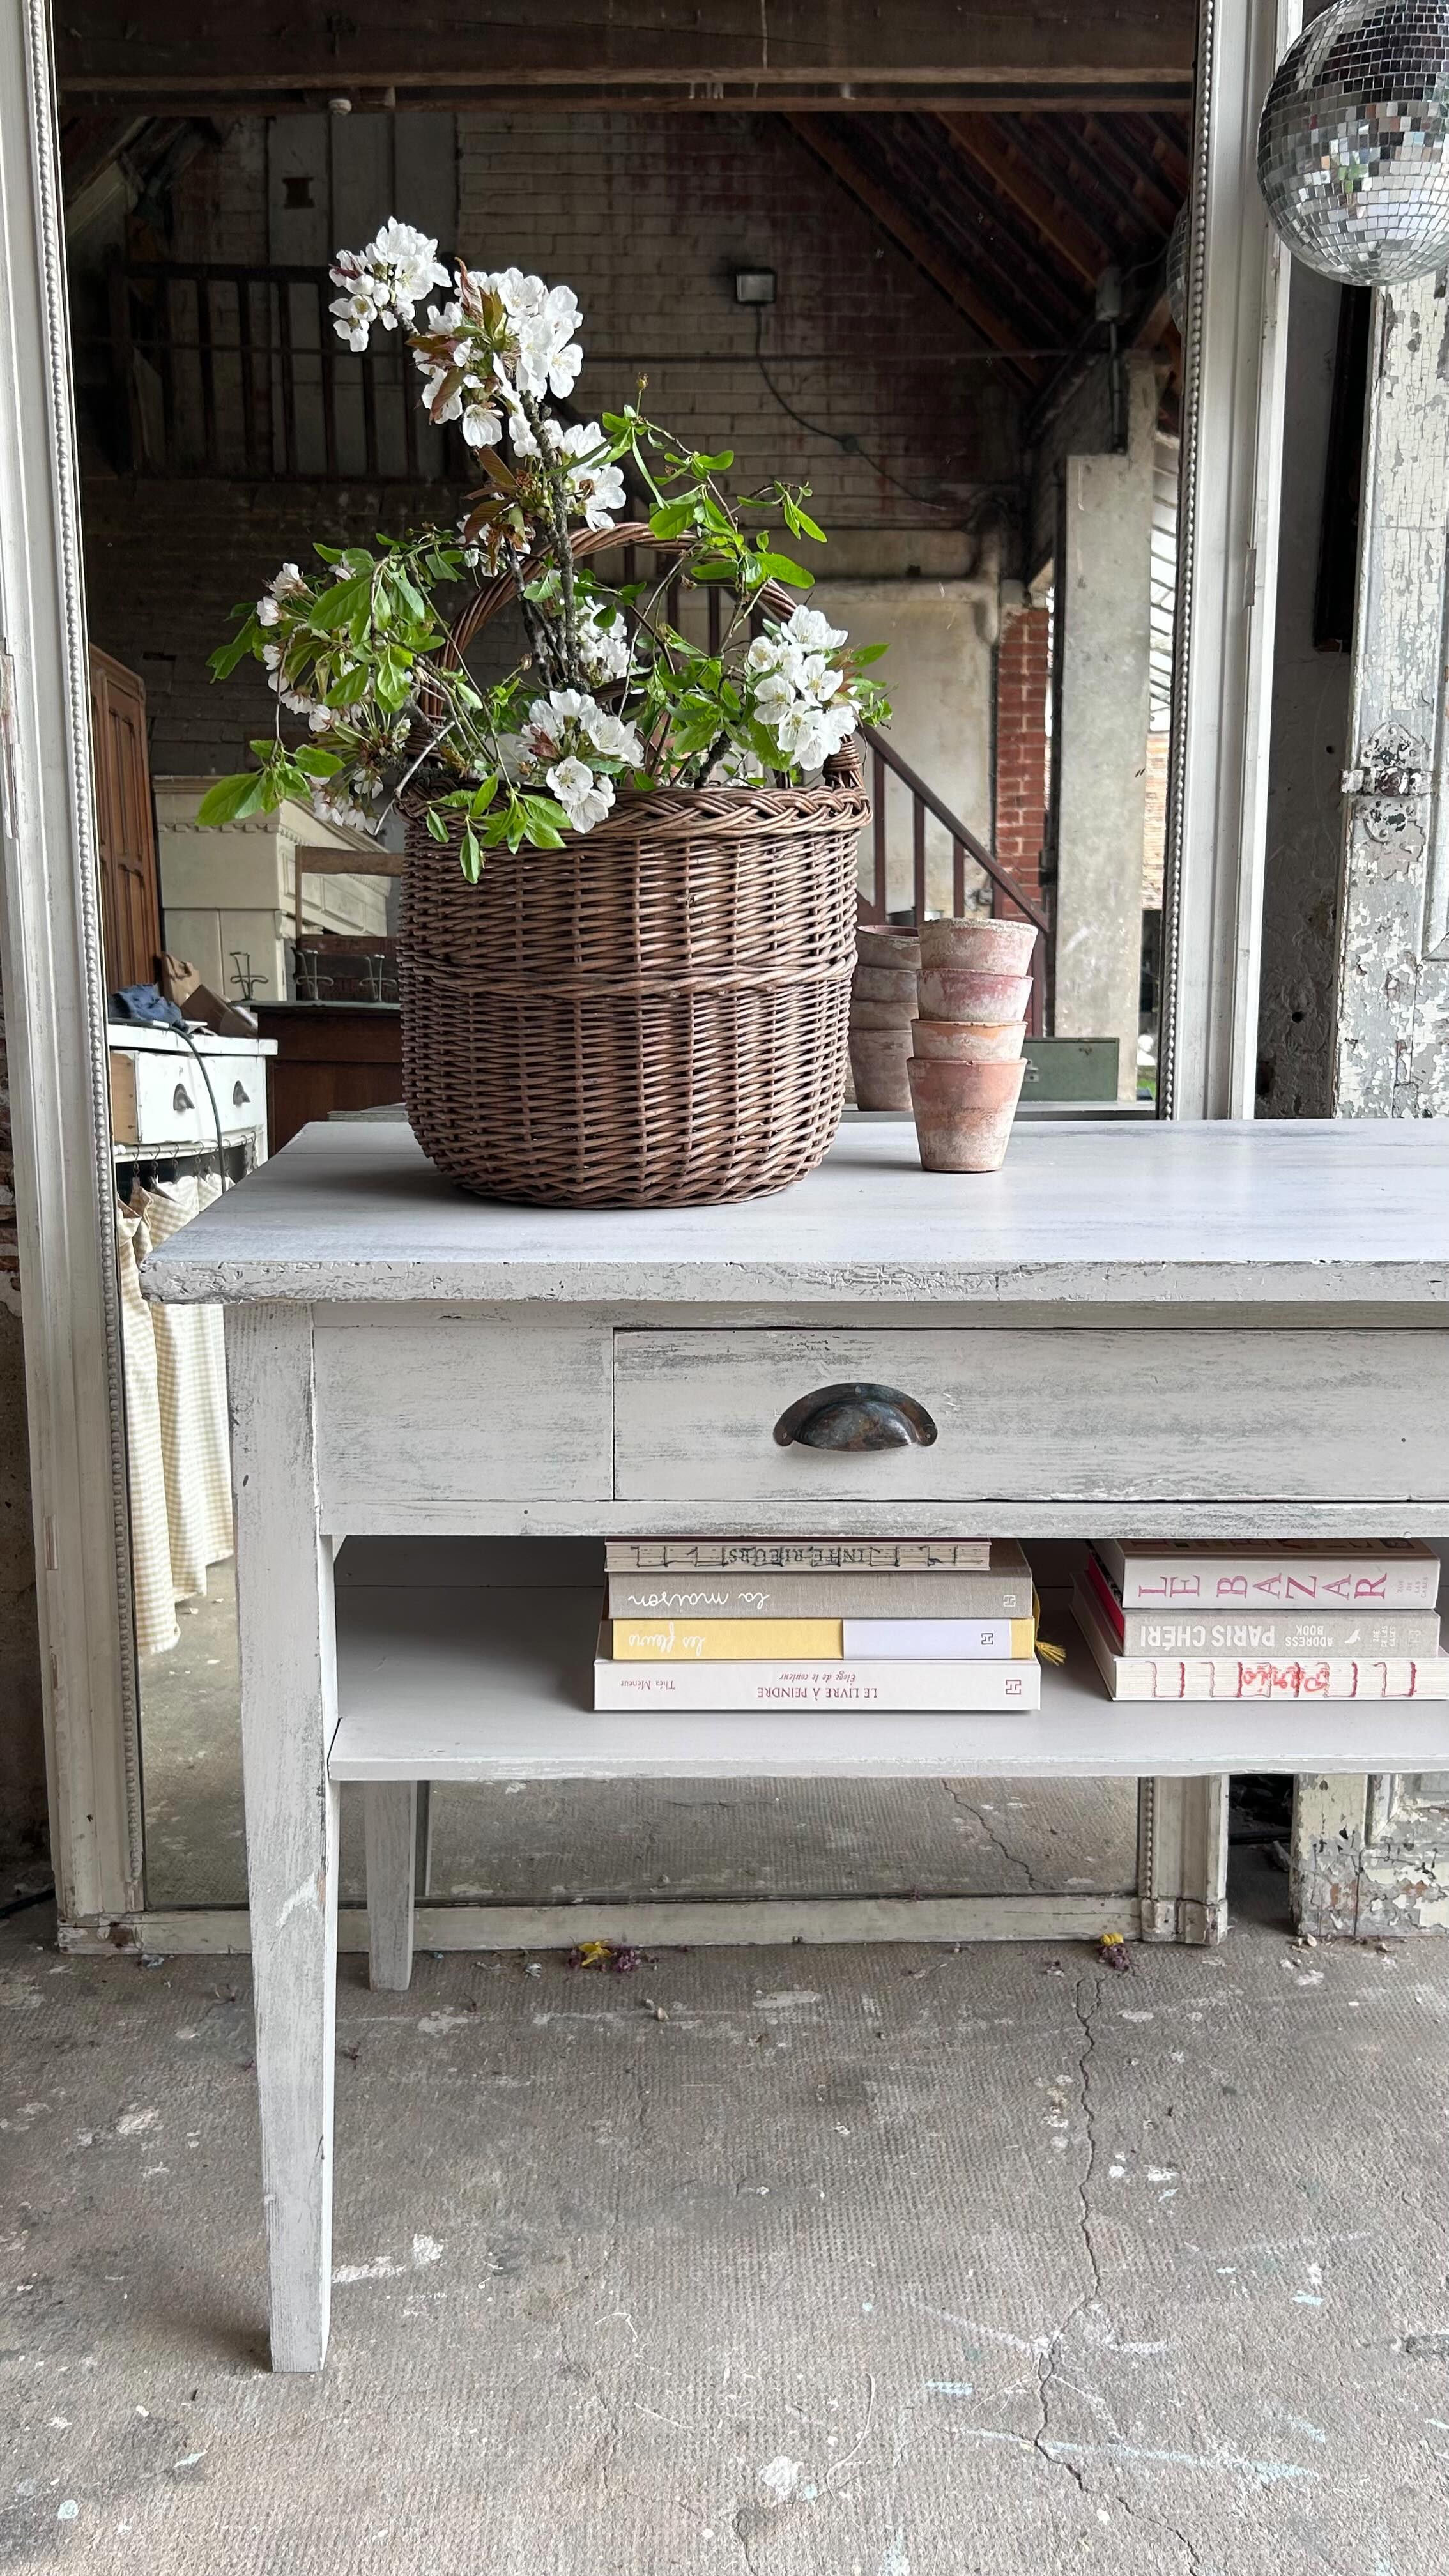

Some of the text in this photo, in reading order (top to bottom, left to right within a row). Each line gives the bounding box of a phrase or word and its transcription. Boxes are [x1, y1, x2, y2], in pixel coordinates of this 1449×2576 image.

[1138, 1572, 1388, 1600] LE BAZAR
[627, 1591, 770, 1613] la maison
[1296, 1625, 1324, 1636] BOOK
[628, 1621, 706, 1657] les fleurs
[1140, 1625, 1275, 1652] PARIS CHÉRI
[1285, 1636, 1333, 1647] ADDRESS
[778, 1672, 809, 1683] couleur
[822, 1673, 832, 1683] de
[756, 1687, 878, 1701] LE LIVRE À PEINDRE
